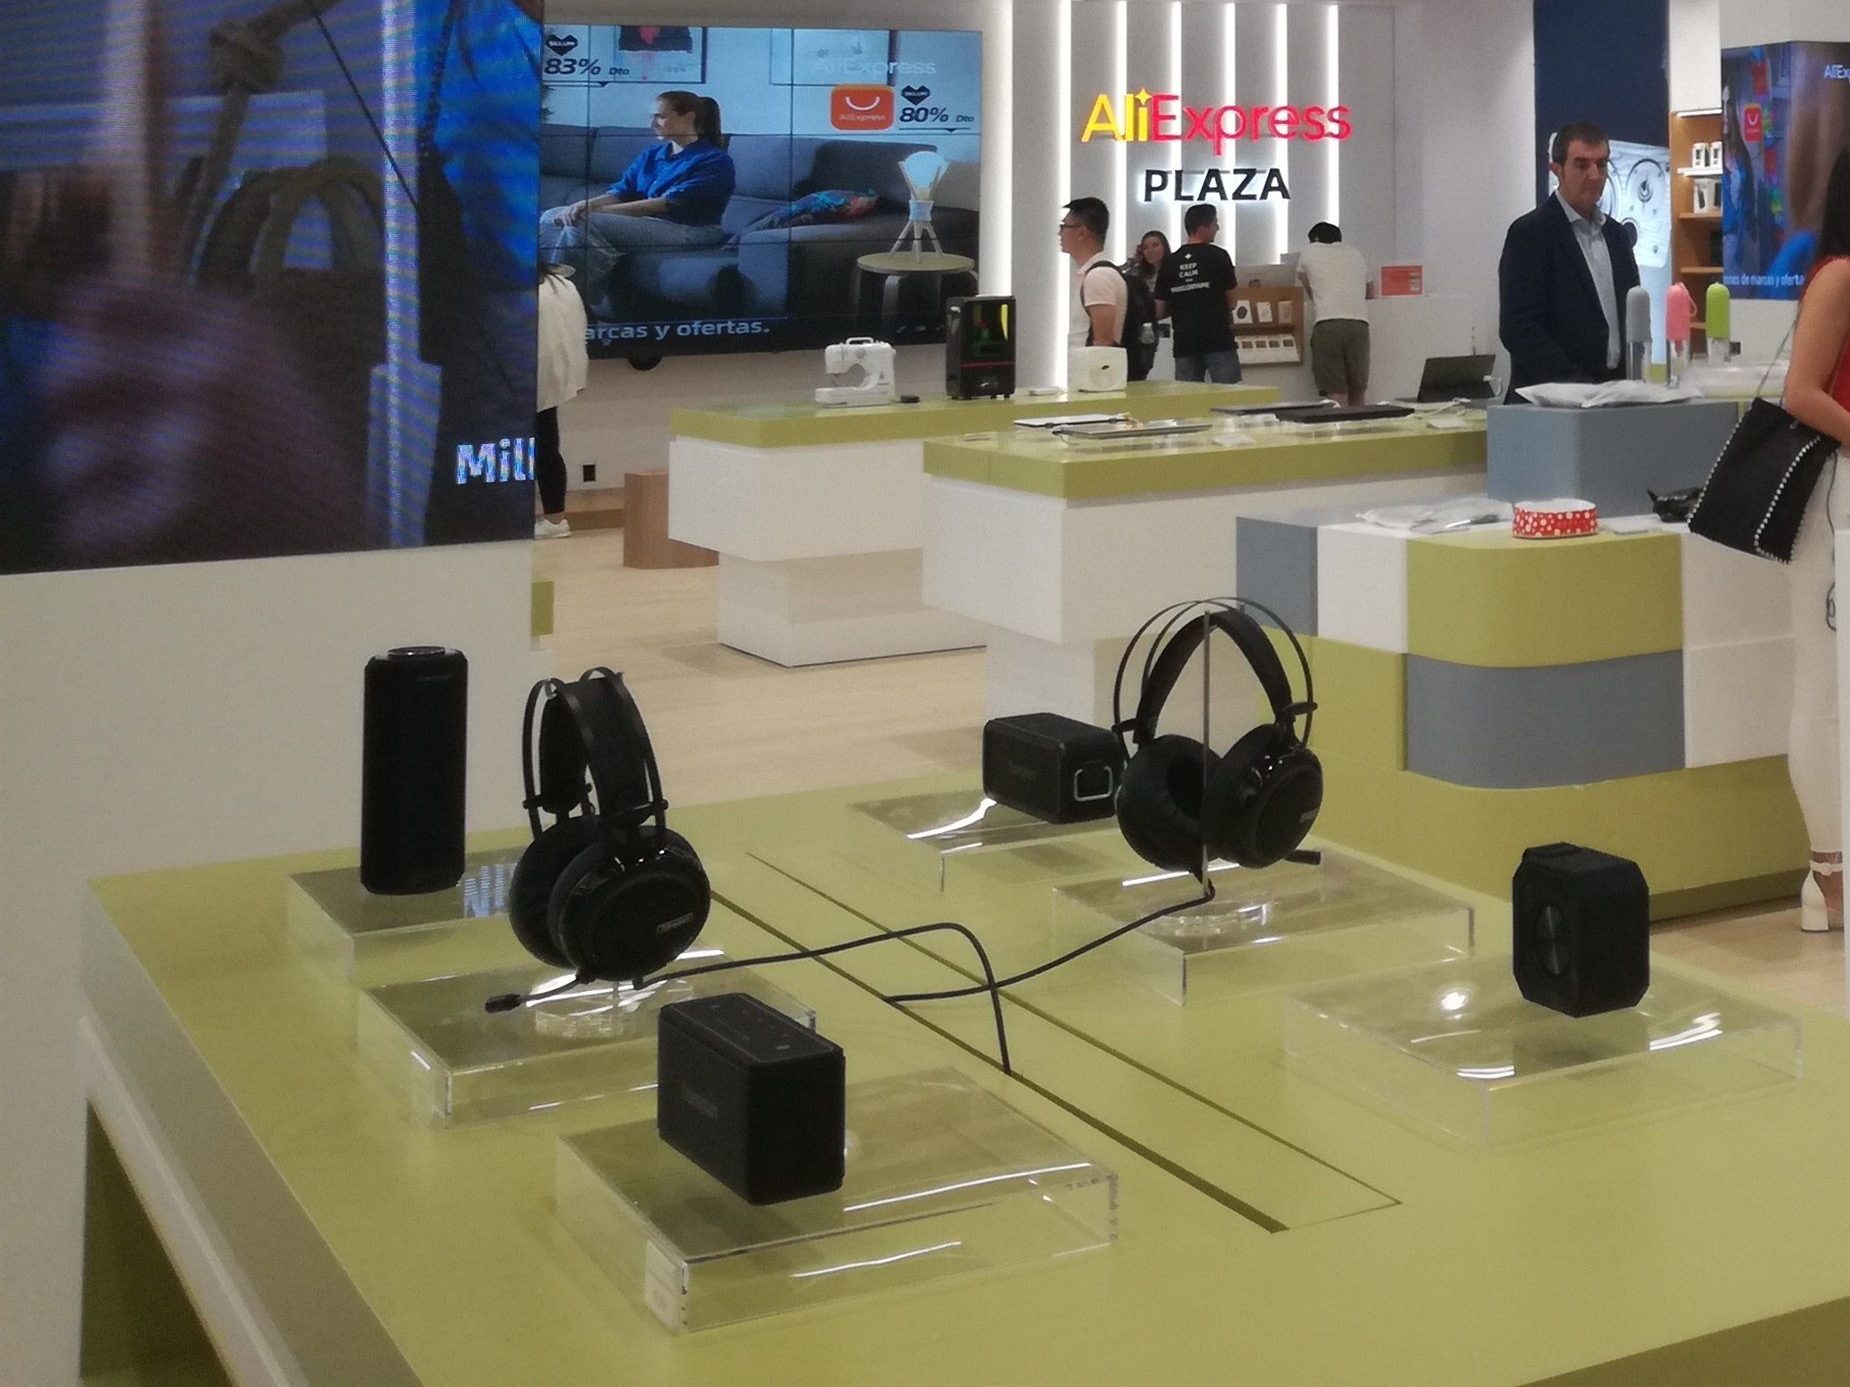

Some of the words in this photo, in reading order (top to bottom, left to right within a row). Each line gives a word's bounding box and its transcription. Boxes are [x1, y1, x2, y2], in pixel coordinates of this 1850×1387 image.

[544, 58, 601, 75] 83%
[899, 107, 949, 123] 80%
[1081, 87, 1352, 156] AliExpress
[1144, 168, 1291, 202] PLAZA
[655, 325, 671, 341] y
[676, 320, 770, 337] ofertas.
